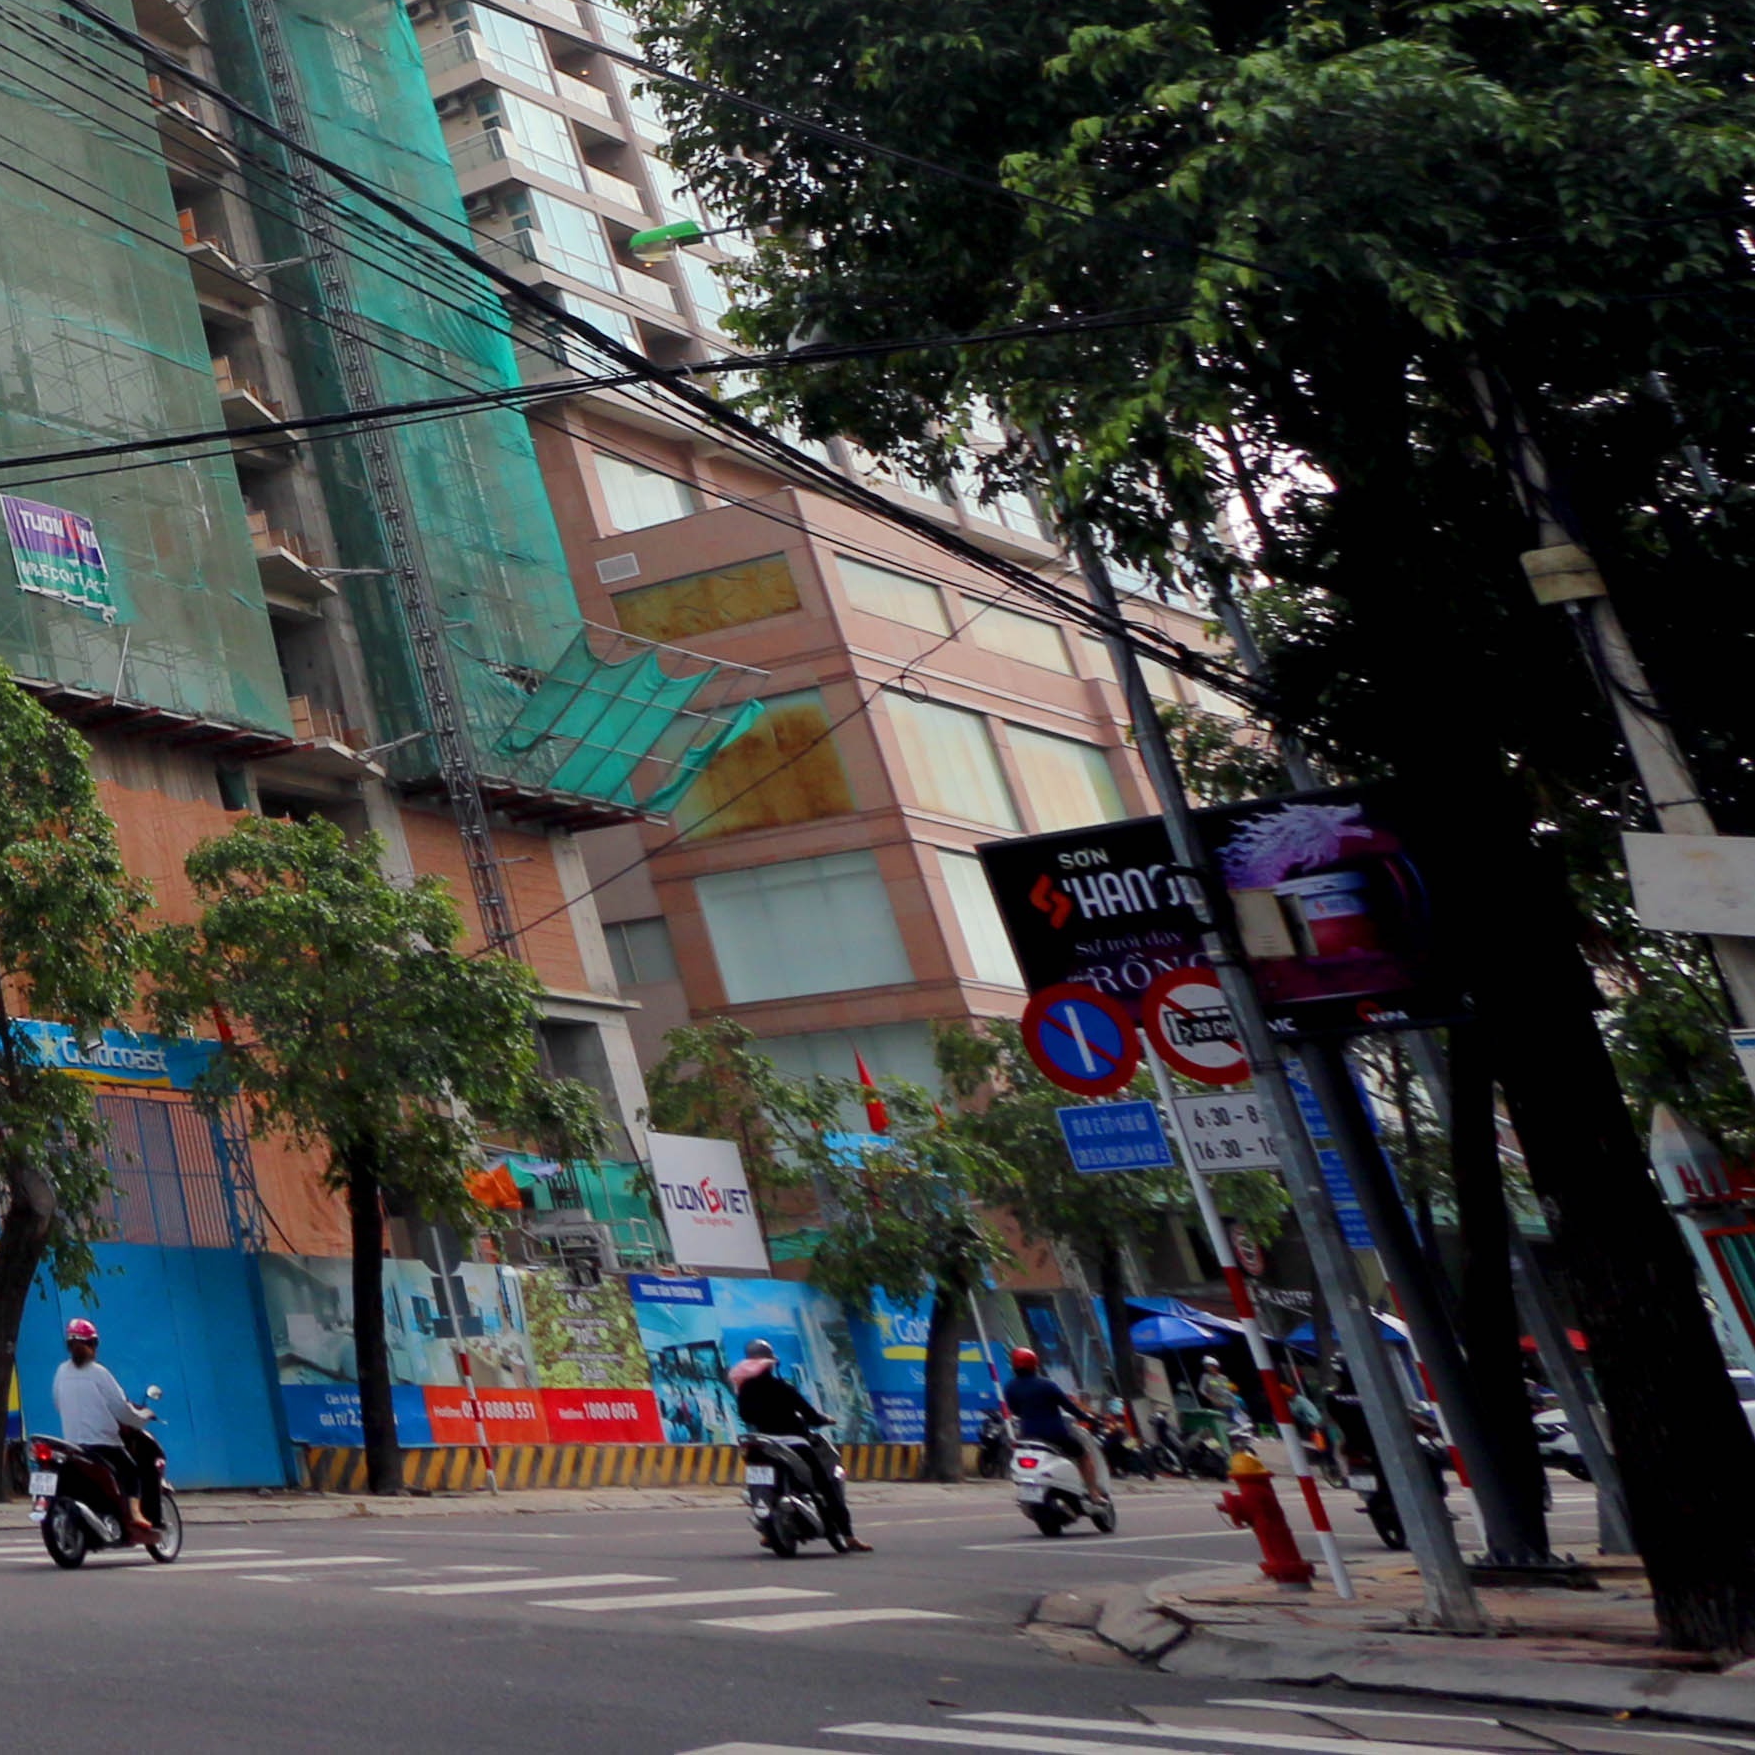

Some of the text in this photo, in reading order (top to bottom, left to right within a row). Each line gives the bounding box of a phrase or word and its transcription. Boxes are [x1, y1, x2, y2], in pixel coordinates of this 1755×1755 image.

[1057, 847, 1110, 869] SƠN
[1193, 1106, 1231, 1128] 6:30
[1195, 1139, 1242, 1160] 16:30
